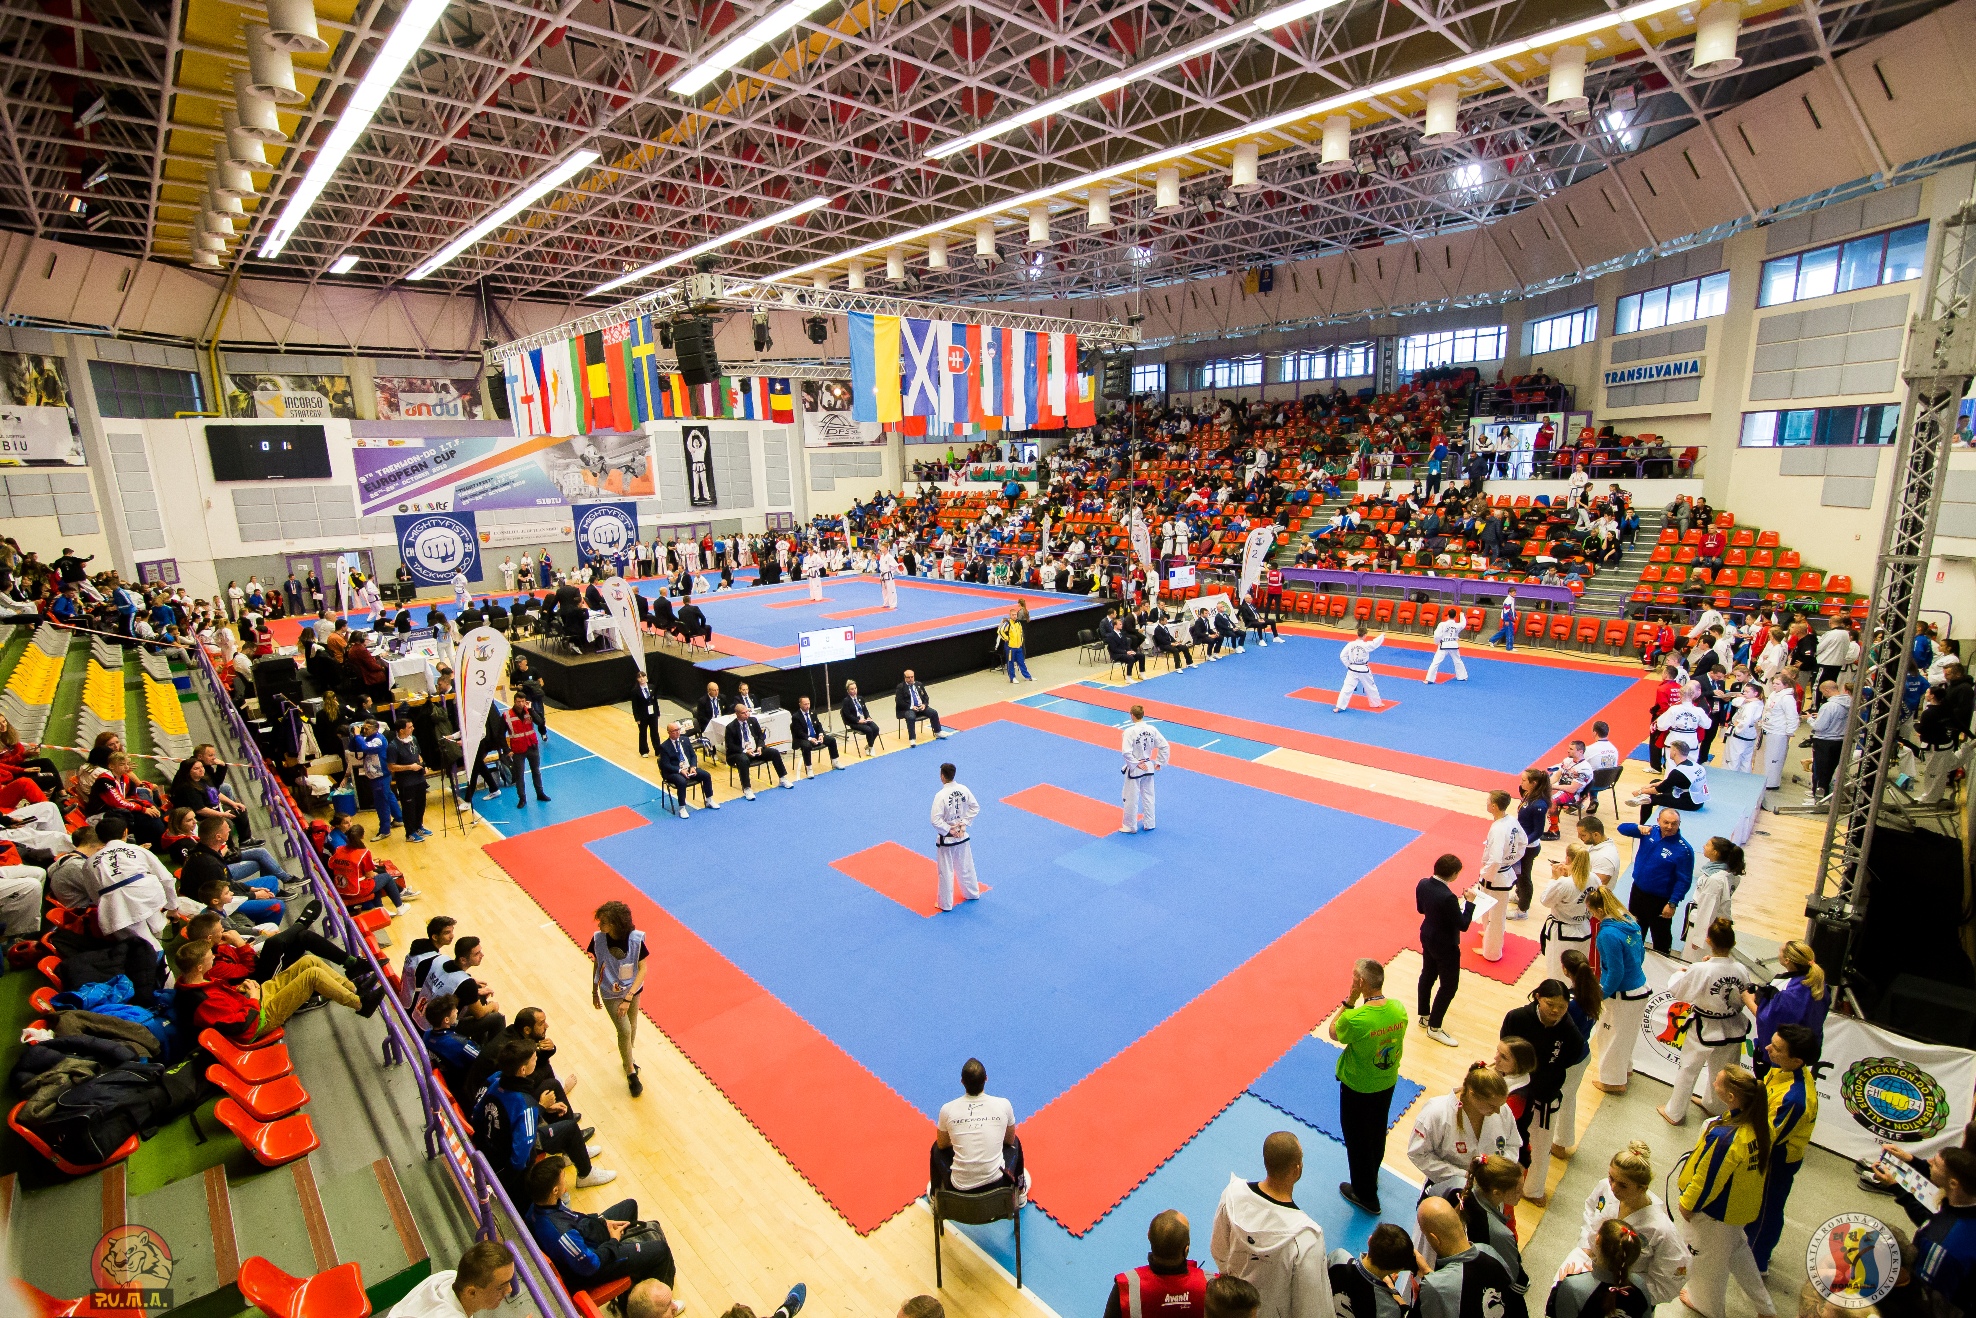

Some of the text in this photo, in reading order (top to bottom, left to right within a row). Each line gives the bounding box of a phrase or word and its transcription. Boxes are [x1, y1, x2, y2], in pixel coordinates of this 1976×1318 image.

[1384, 350, 1392, 392] PRESA
[1604, 360, 1699, 385] TRANSILVANIA
[363, 449, 457, 493] EUROPEAN CUP
[375, 448, 437, 477] TAEKWON-DO
[535, 497, 562, 505] SIBIU
[583, 508, 633, 529] MIGHTYFIST
[408, 519, 468, 542] MIGHTYFIST
[1250, 549, 1259, 559] 2
[475, 669, 487, 686] 3
[1710, 976, 1746, 996] TAEKWOND
[1854, 1066, 1936, 1131] ALL EUROPE TAEKWON-DO FEDERATION
[1164, 1291, 1190, 1303] Avanti
